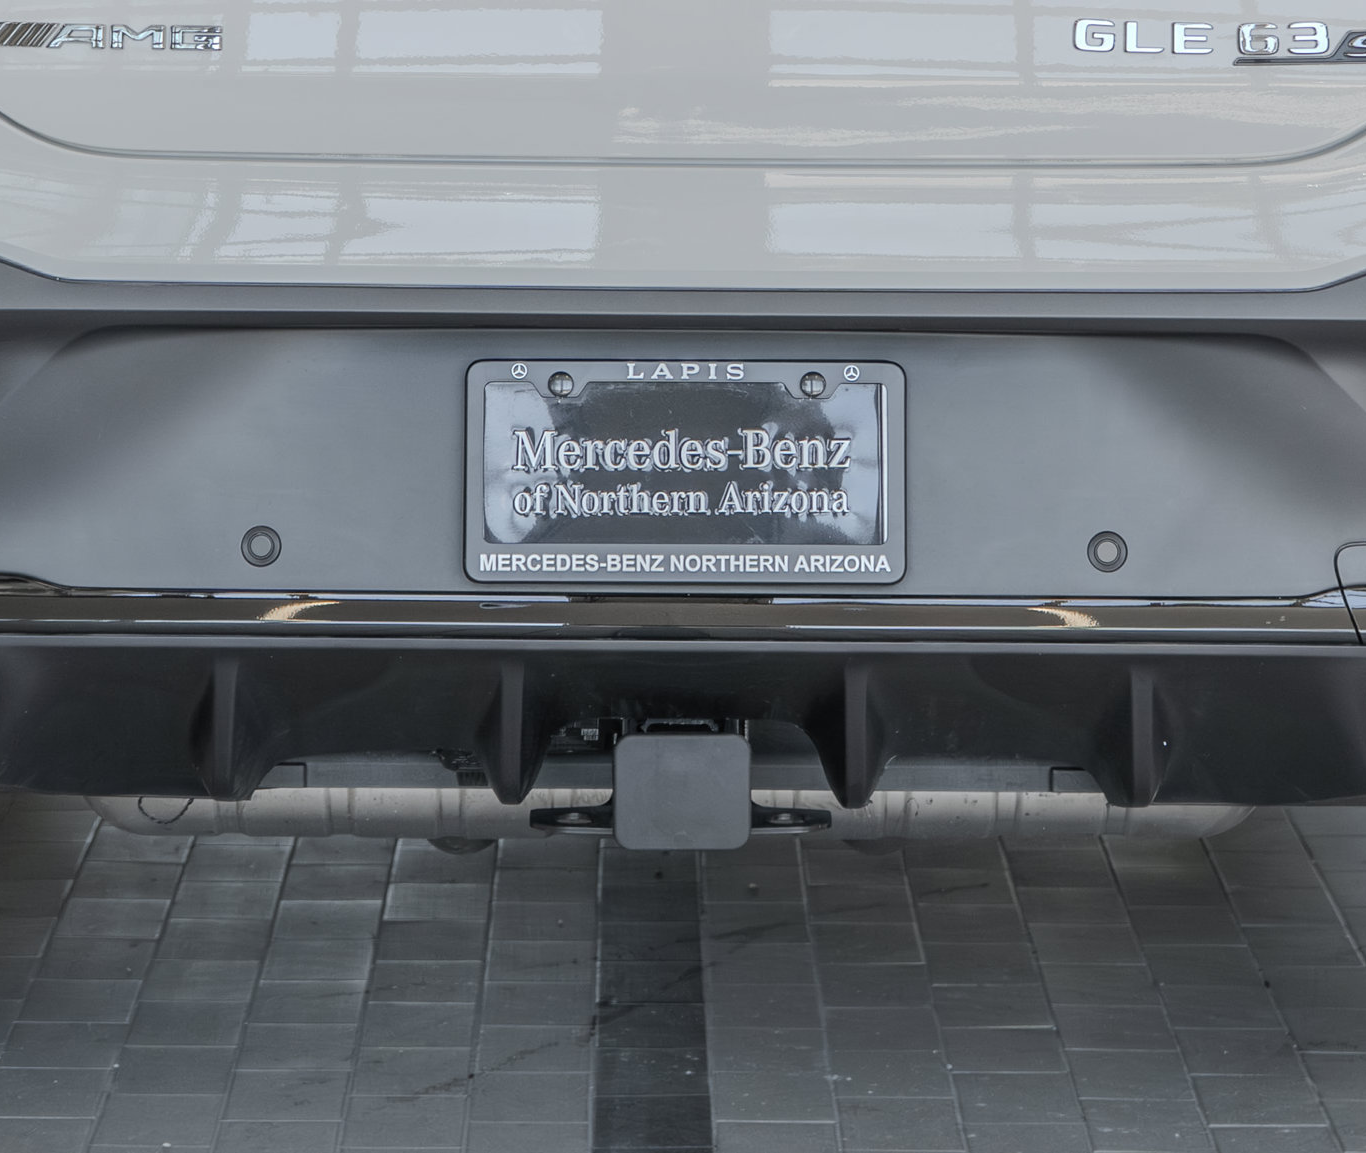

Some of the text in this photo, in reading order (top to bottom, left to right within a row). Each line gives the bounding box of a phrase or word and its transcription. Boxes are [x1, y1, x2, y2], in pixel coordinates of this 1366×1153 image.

[46, 23, 223, 51] AMG
[1073, 18, 1214, 55] GLE
[626, 363, 745, 380] LAPIS
[512, 429, 851, 470] Mercedes-Benz
[513, 482, 850, 515] of Northern Arizona
[479, 554, 892, 573] MERCEDES-BENZ NORTHERN ARIZONA
